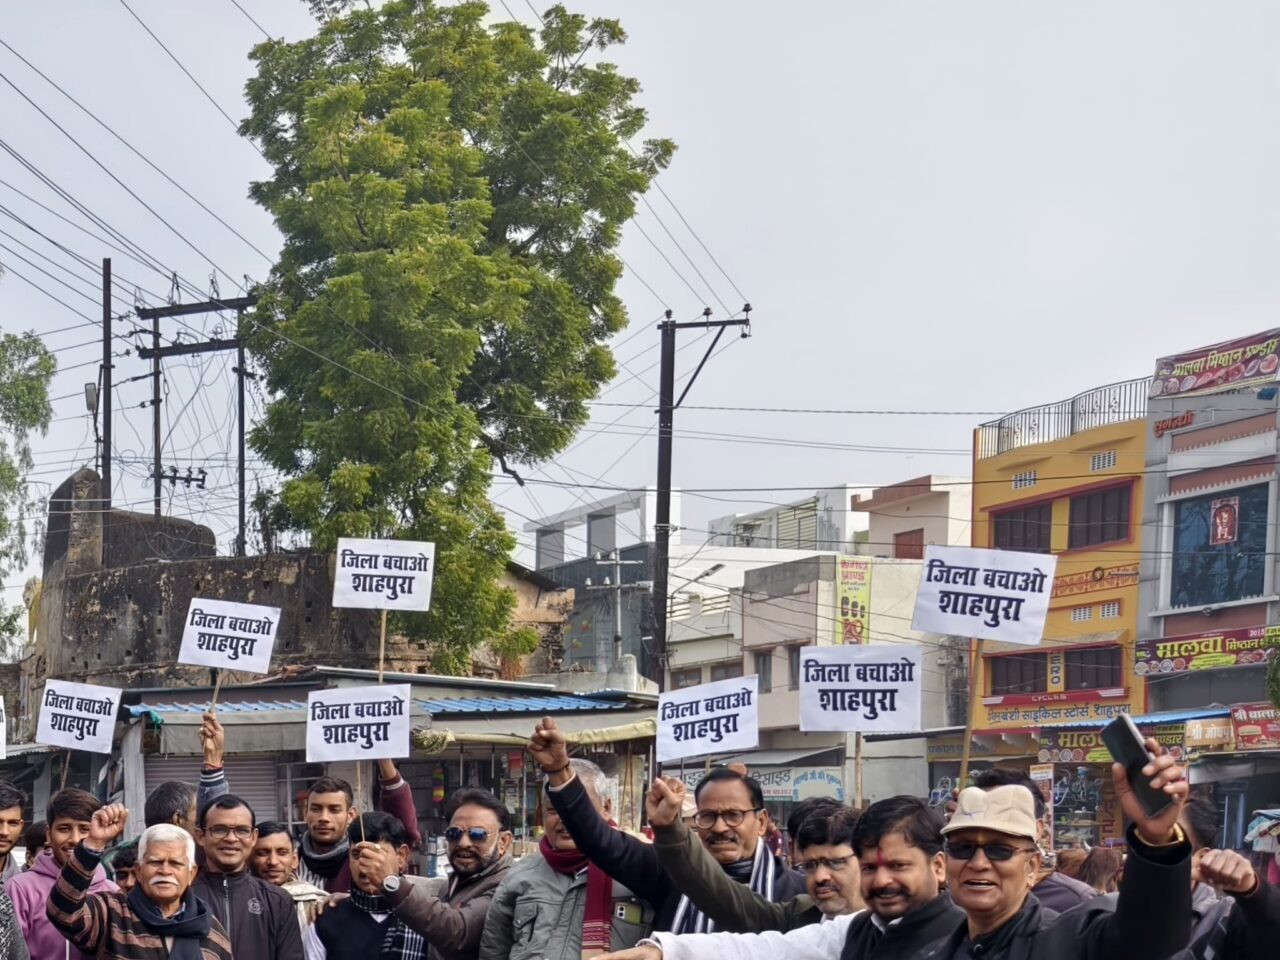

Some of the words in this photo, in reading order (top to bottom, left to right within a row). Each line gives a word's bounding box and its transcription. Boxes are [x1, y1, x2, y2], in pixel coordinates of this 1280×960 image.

[341, 549, 378, 568] जिला
[382, 553, 429, 571] बचाओ
[351, 573, 415, 600] शाहपुरा
[926, 559, 978, 586] जिला
[984, 567, 1047, 594] बचाओ
[189, 608, 224, 630] जिला
[228, 616, 273, 635] बचाओ
[938, 591, 1025, 628] शाहपुरा
[197, 632, 257, 660] शाहपुरा
[1156, 636, 1224, 658] मालवा
[803, 659, 850, 682] जिला
[855, 657, 915, 683] बचाओ
[45, 689, 74, 710] जिला
[76, 697, 114, 716] बचाओ
[311, 702, 349, 721] जिला
[354, 696, 404, 717] बचाओ
[660, 699, 700, 721] जिला
[703, 687, 753, 715] बचाओ
[818, 688, 898, 720] शाहपुरा
[50, 712, 99, 740] शाहपुरा
[322, 722, 390, 749] शाहपुरा
[673, 713, 739, 743] शाहपुरा
